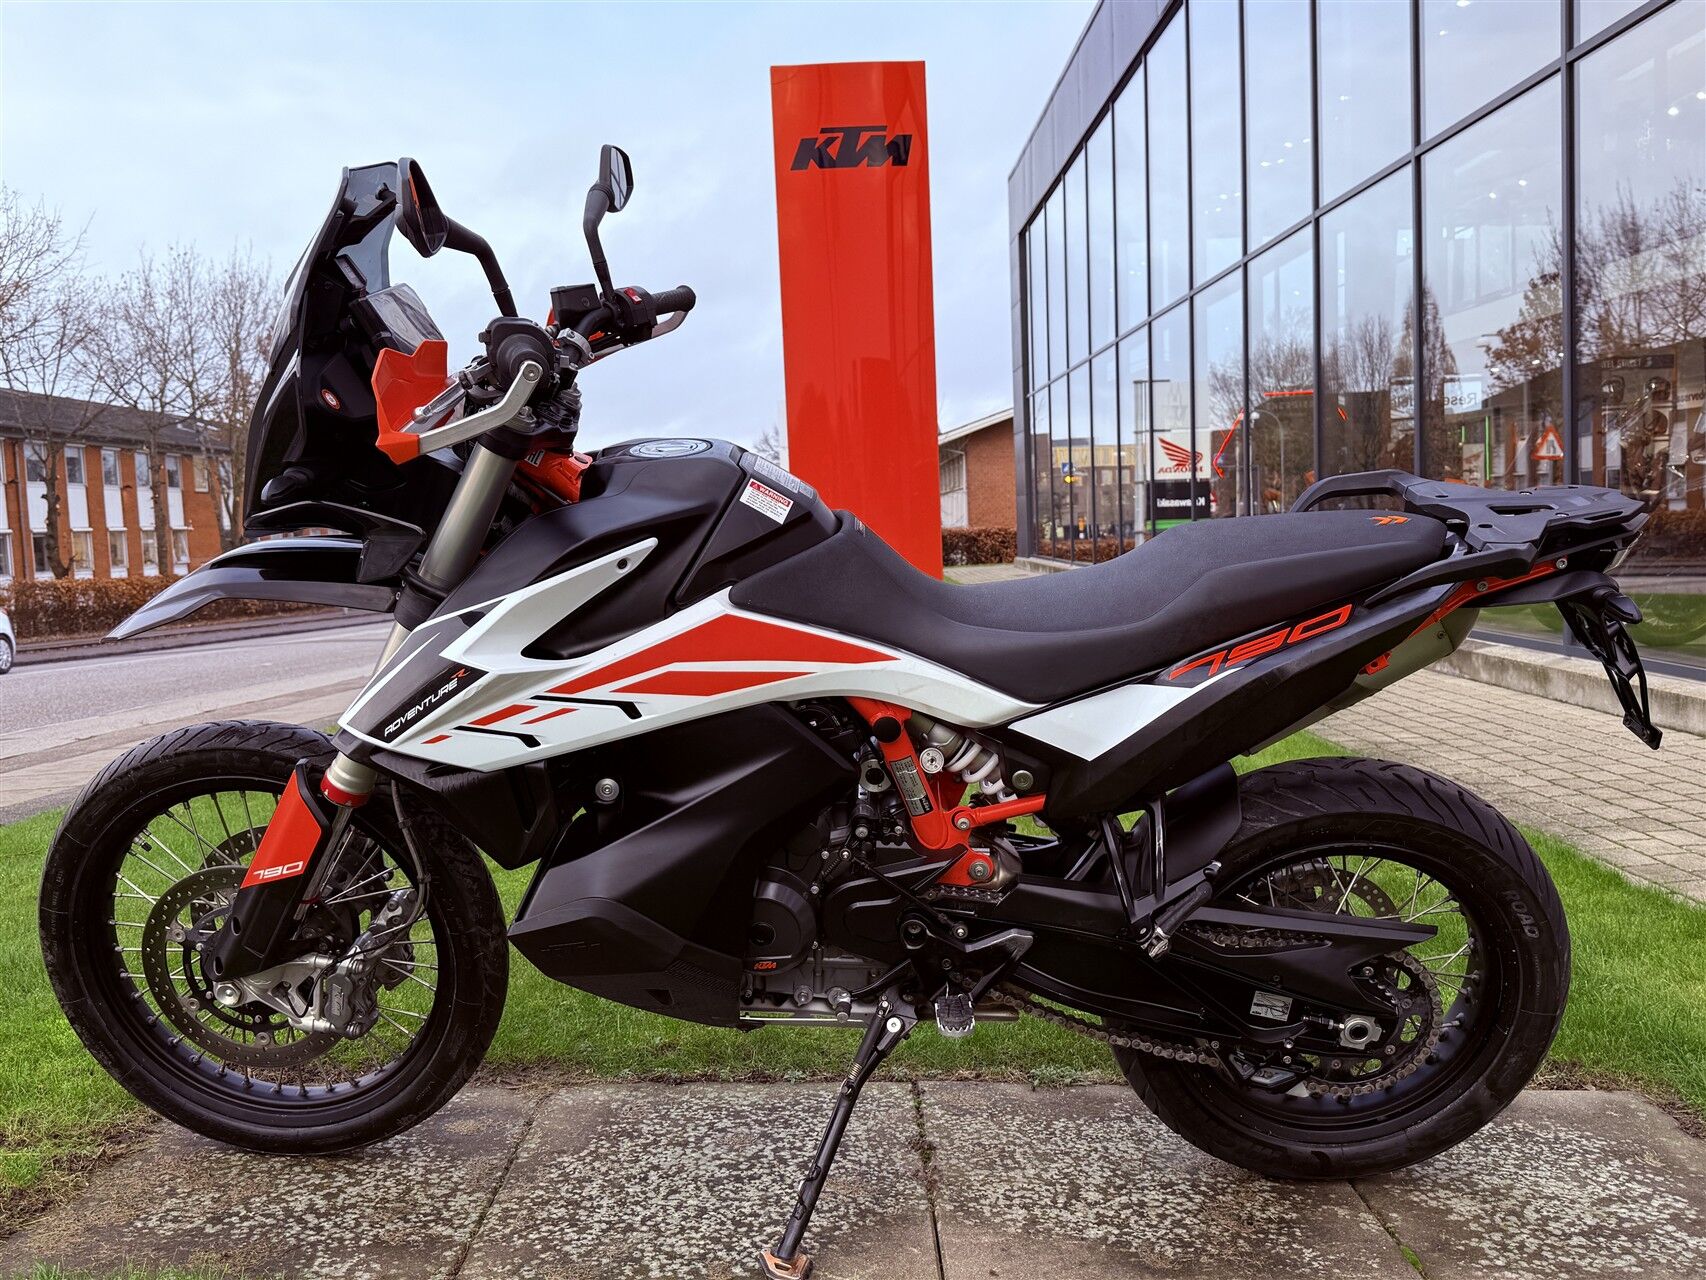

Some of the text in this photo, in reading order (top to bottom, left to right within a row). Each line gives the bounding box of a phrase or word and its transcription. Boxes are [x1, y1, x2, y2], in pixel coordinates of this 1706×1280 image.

[790, 125, 913, 171] KTM
[759, 486, 790, 506] WARNING
[1168, 604, 1353, 681] 790
[384, 678, 458, 738] ADVENTURE
[253, 861, 304, 880] 790
[1499, 889, 1540, 939] ROAD
